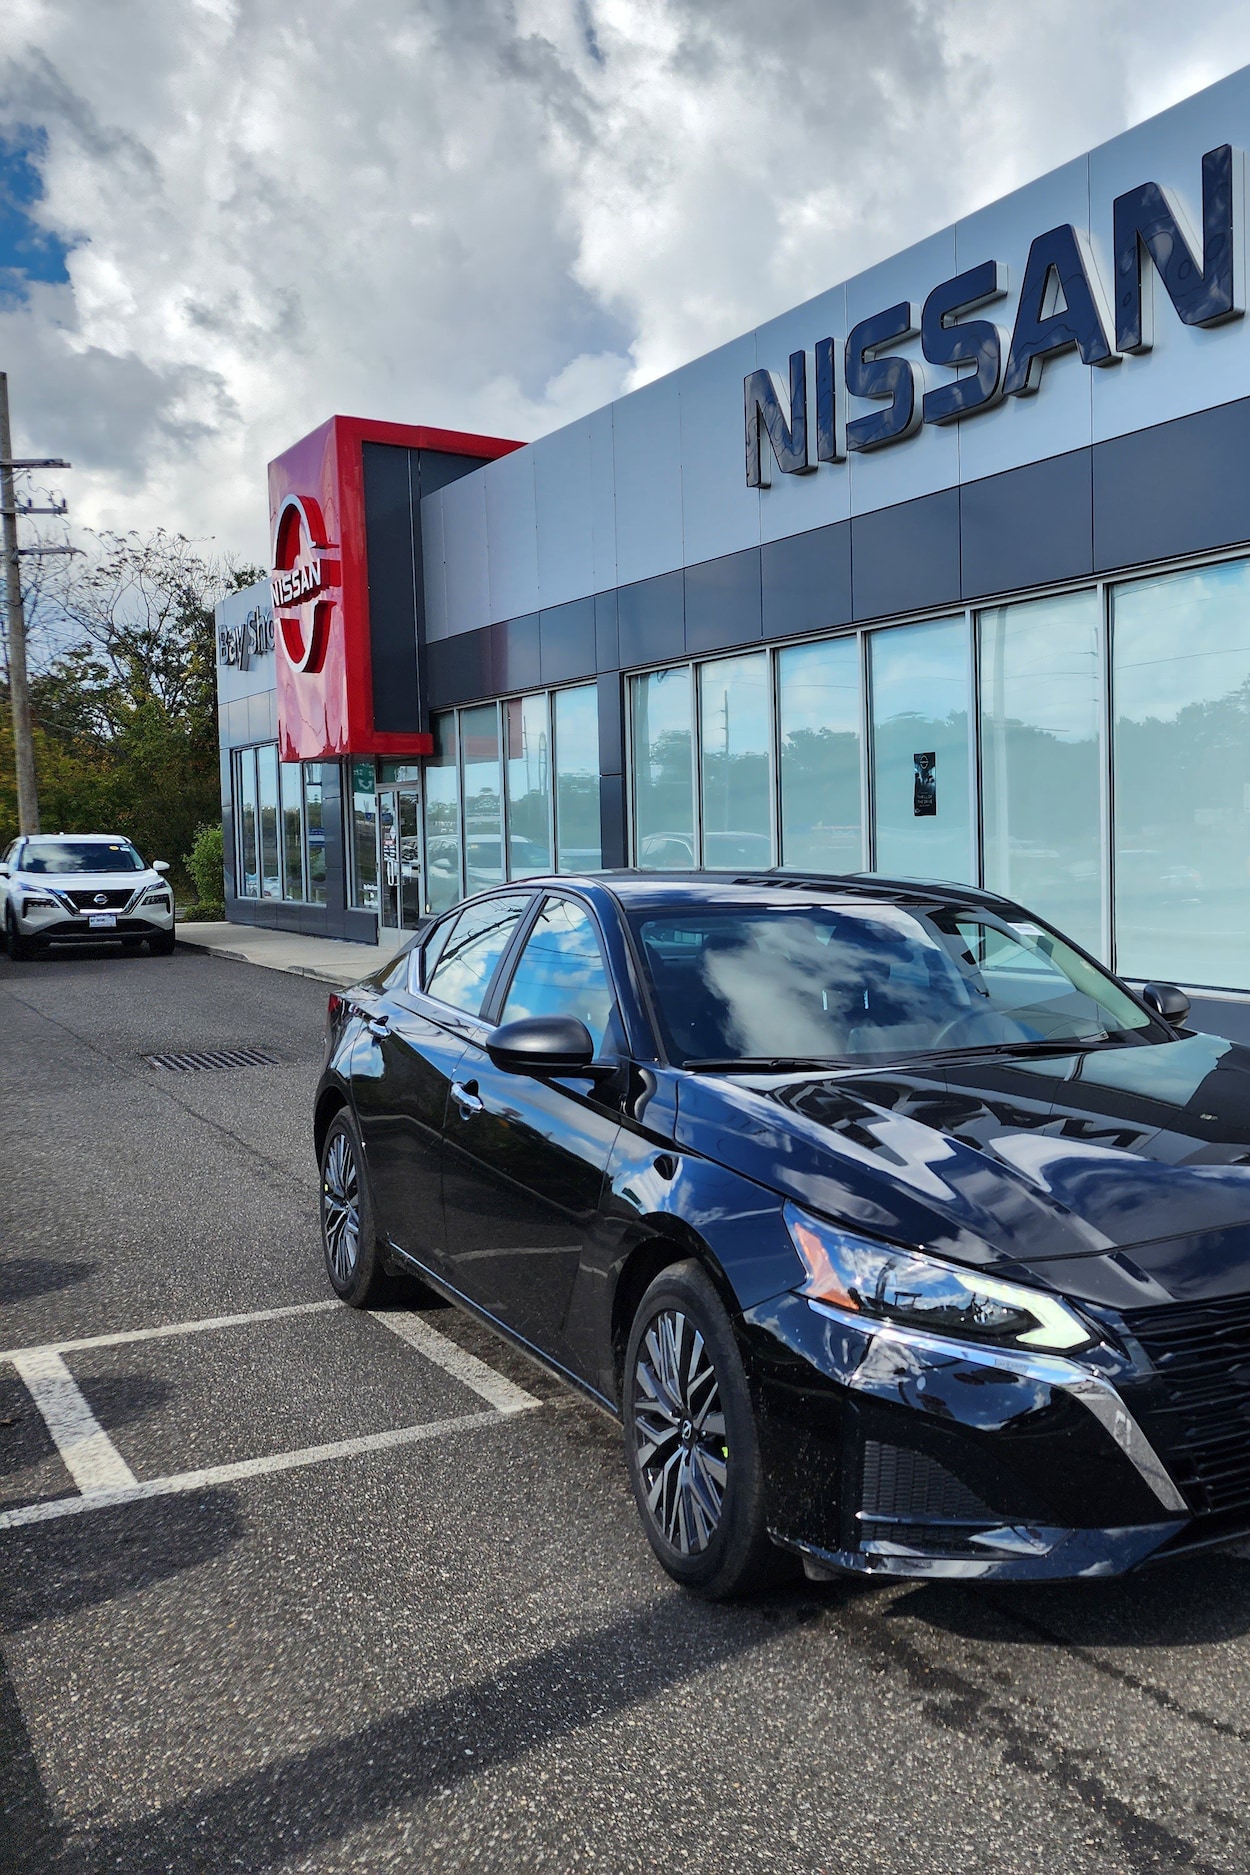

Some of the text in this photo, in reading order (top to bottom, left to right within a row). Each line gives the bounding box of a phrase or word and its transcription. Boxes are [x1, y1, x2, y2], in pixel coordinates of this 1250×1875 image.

[744, 143, 1242, 489] NISSAN
[270, 558, 321, 607] NISSAN
[218, 606, 275, 671] Bay Sho
